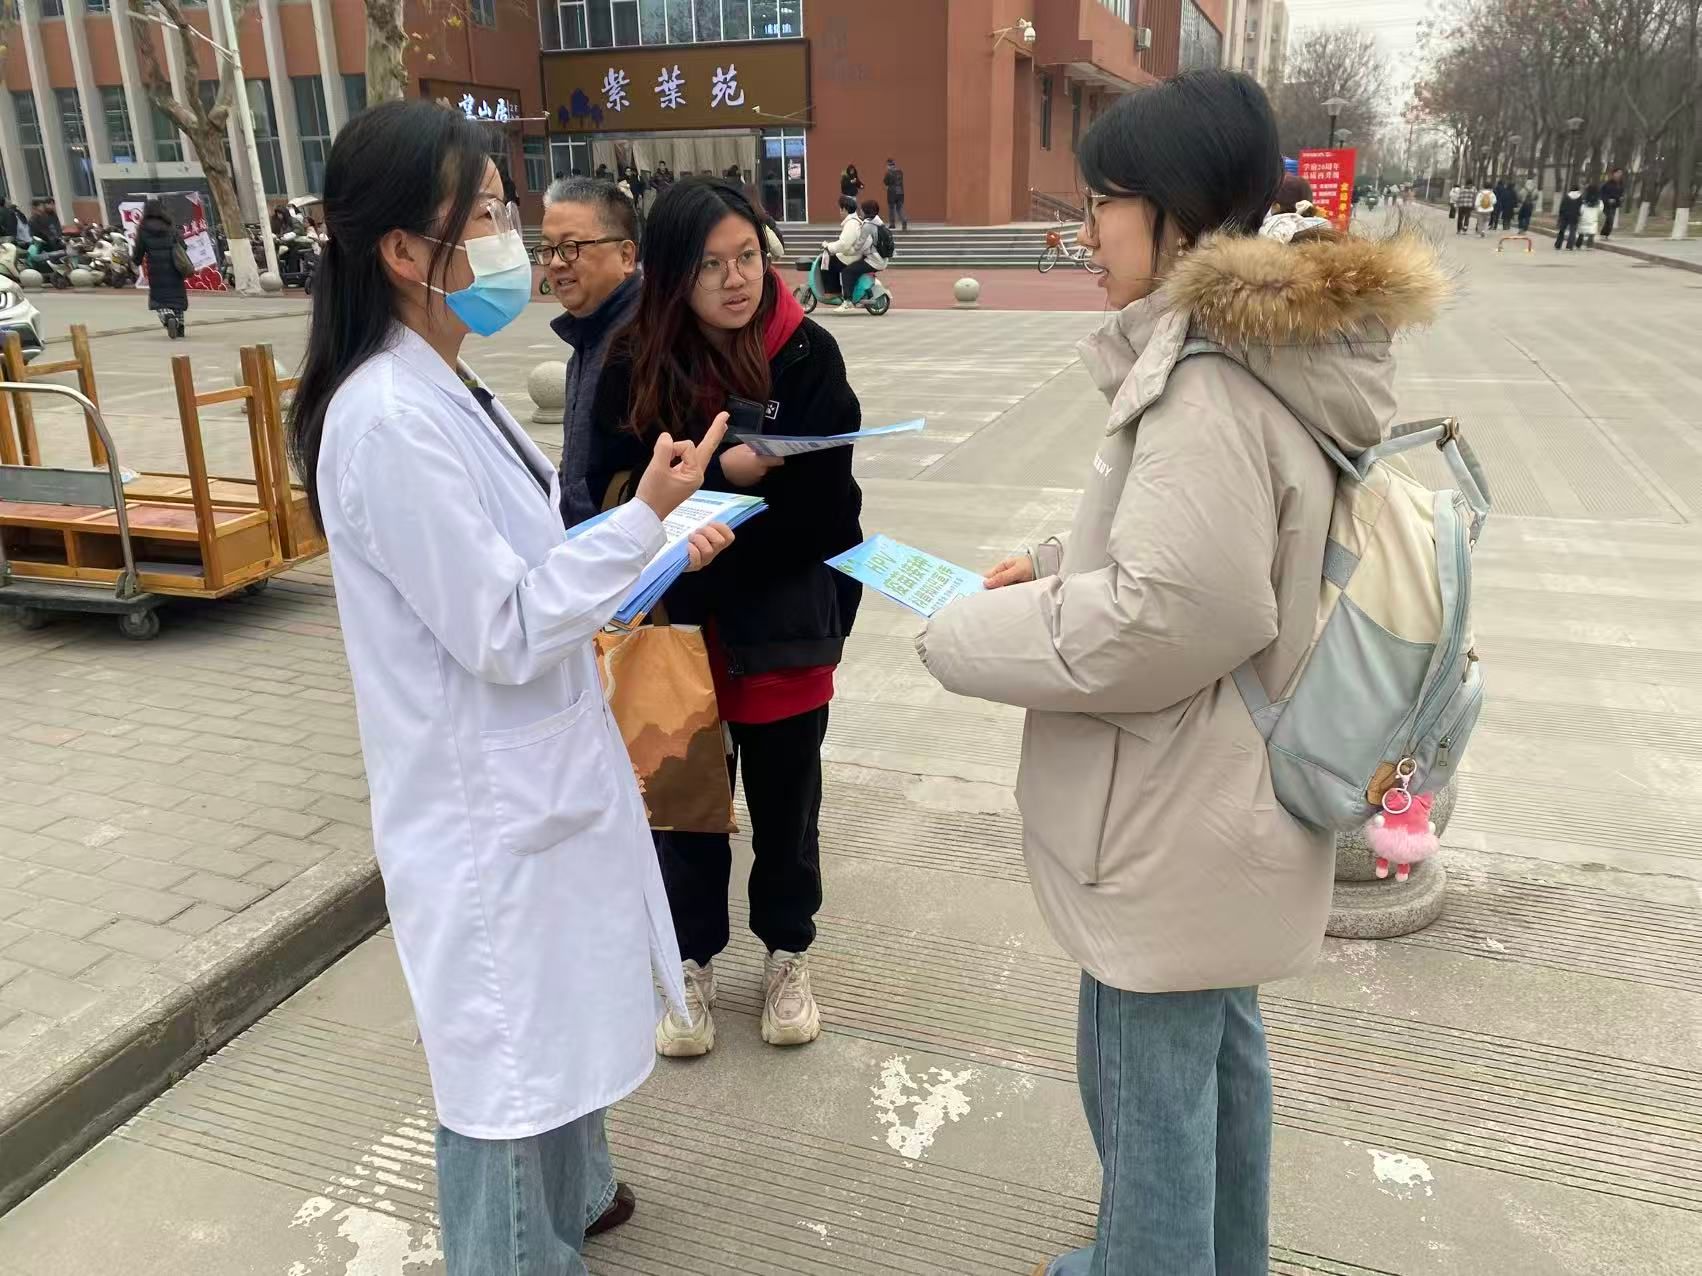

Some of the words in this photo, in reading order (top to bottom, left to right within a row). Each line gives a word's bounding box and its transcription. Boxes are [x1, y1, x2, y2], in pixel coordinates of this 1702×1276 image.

[602, 64, 744, 112] 紫葉苑
[865, 551, 896, 574] HPV
